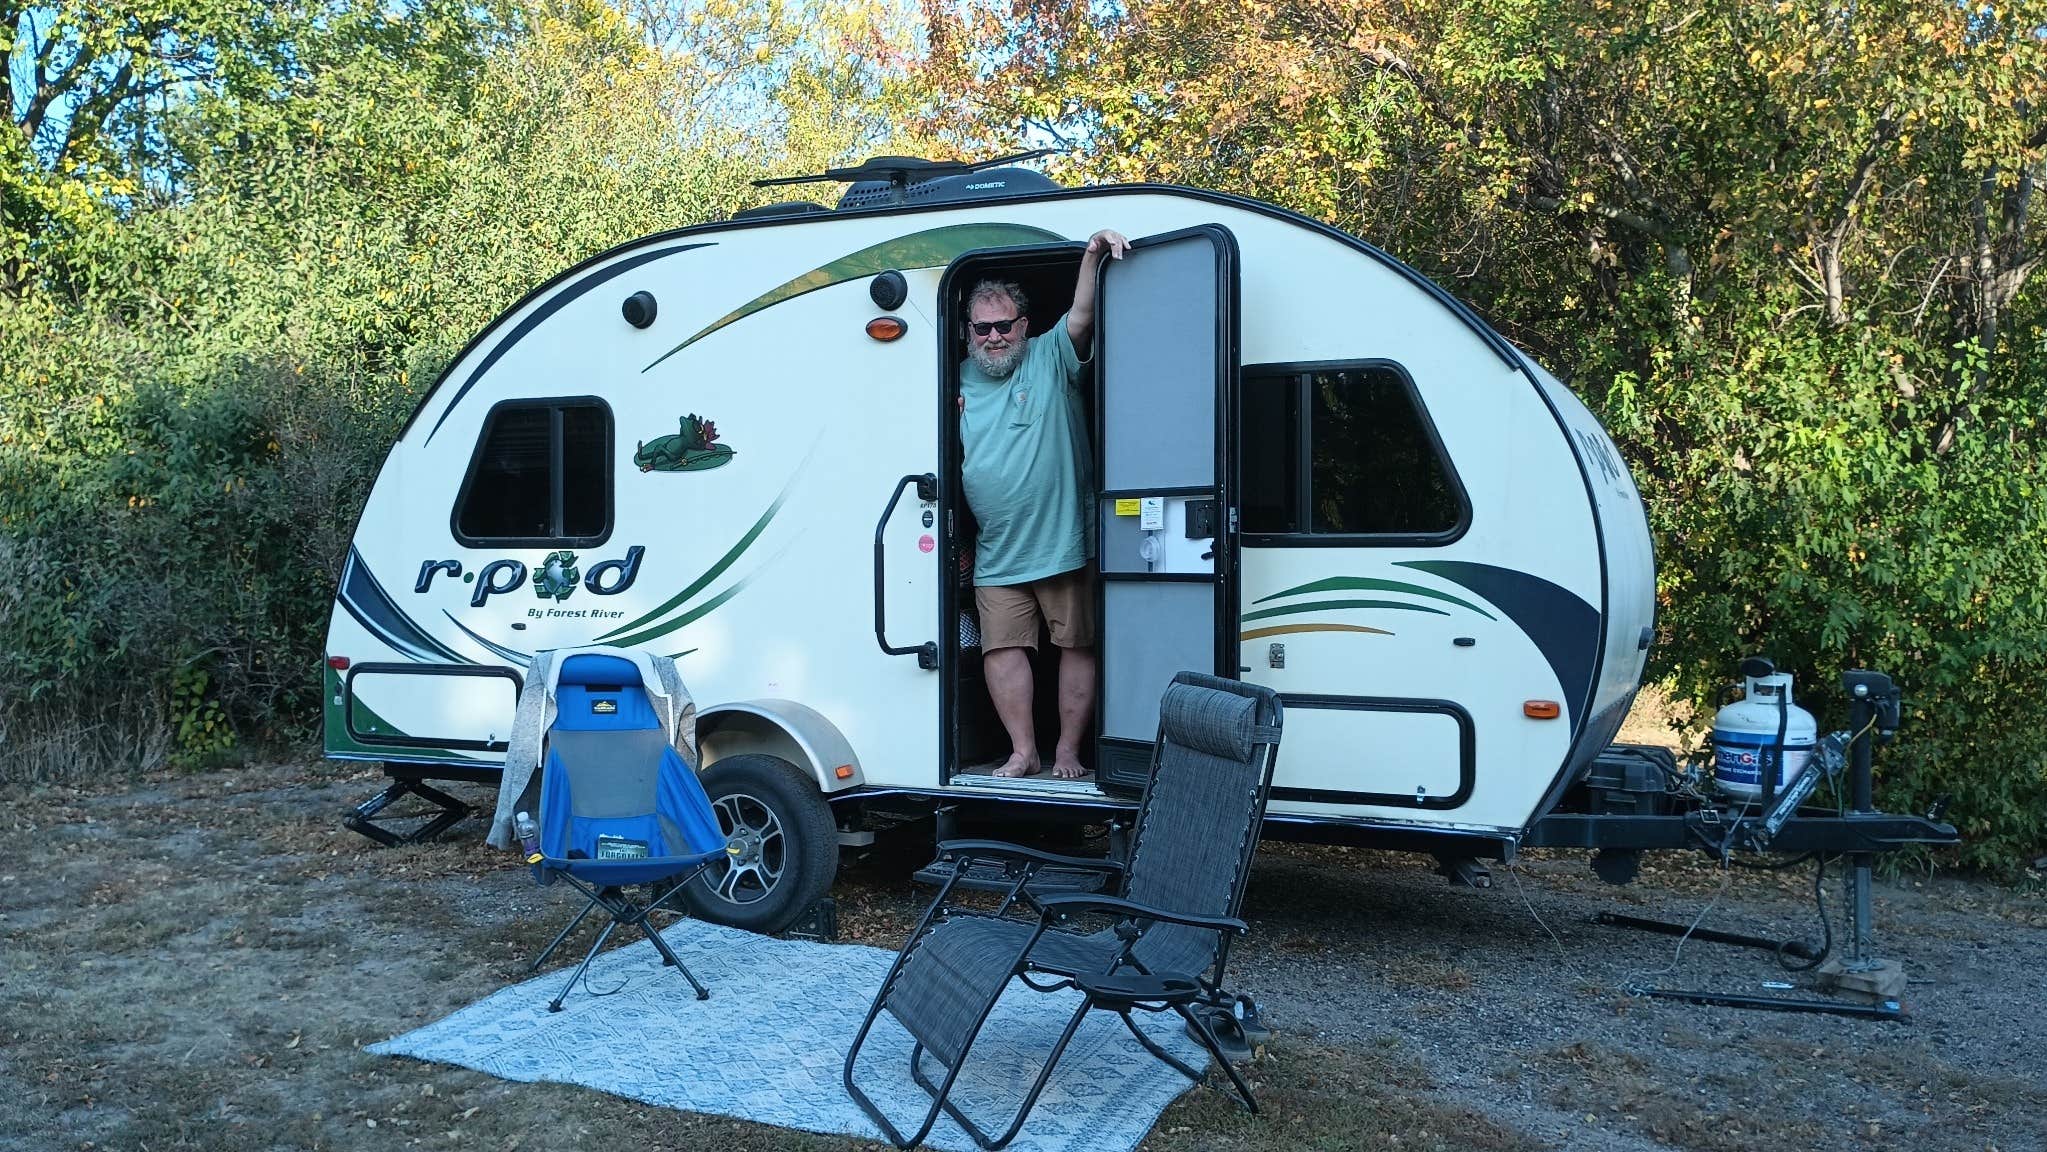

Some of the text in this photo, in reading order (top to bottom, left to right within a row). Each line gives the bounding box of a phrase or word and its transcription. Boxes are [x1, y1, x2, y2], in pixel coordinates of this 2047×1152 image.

[974, 181, 1006, 190] DOMETIC
[528, 608, 625, 619] By Forest River
